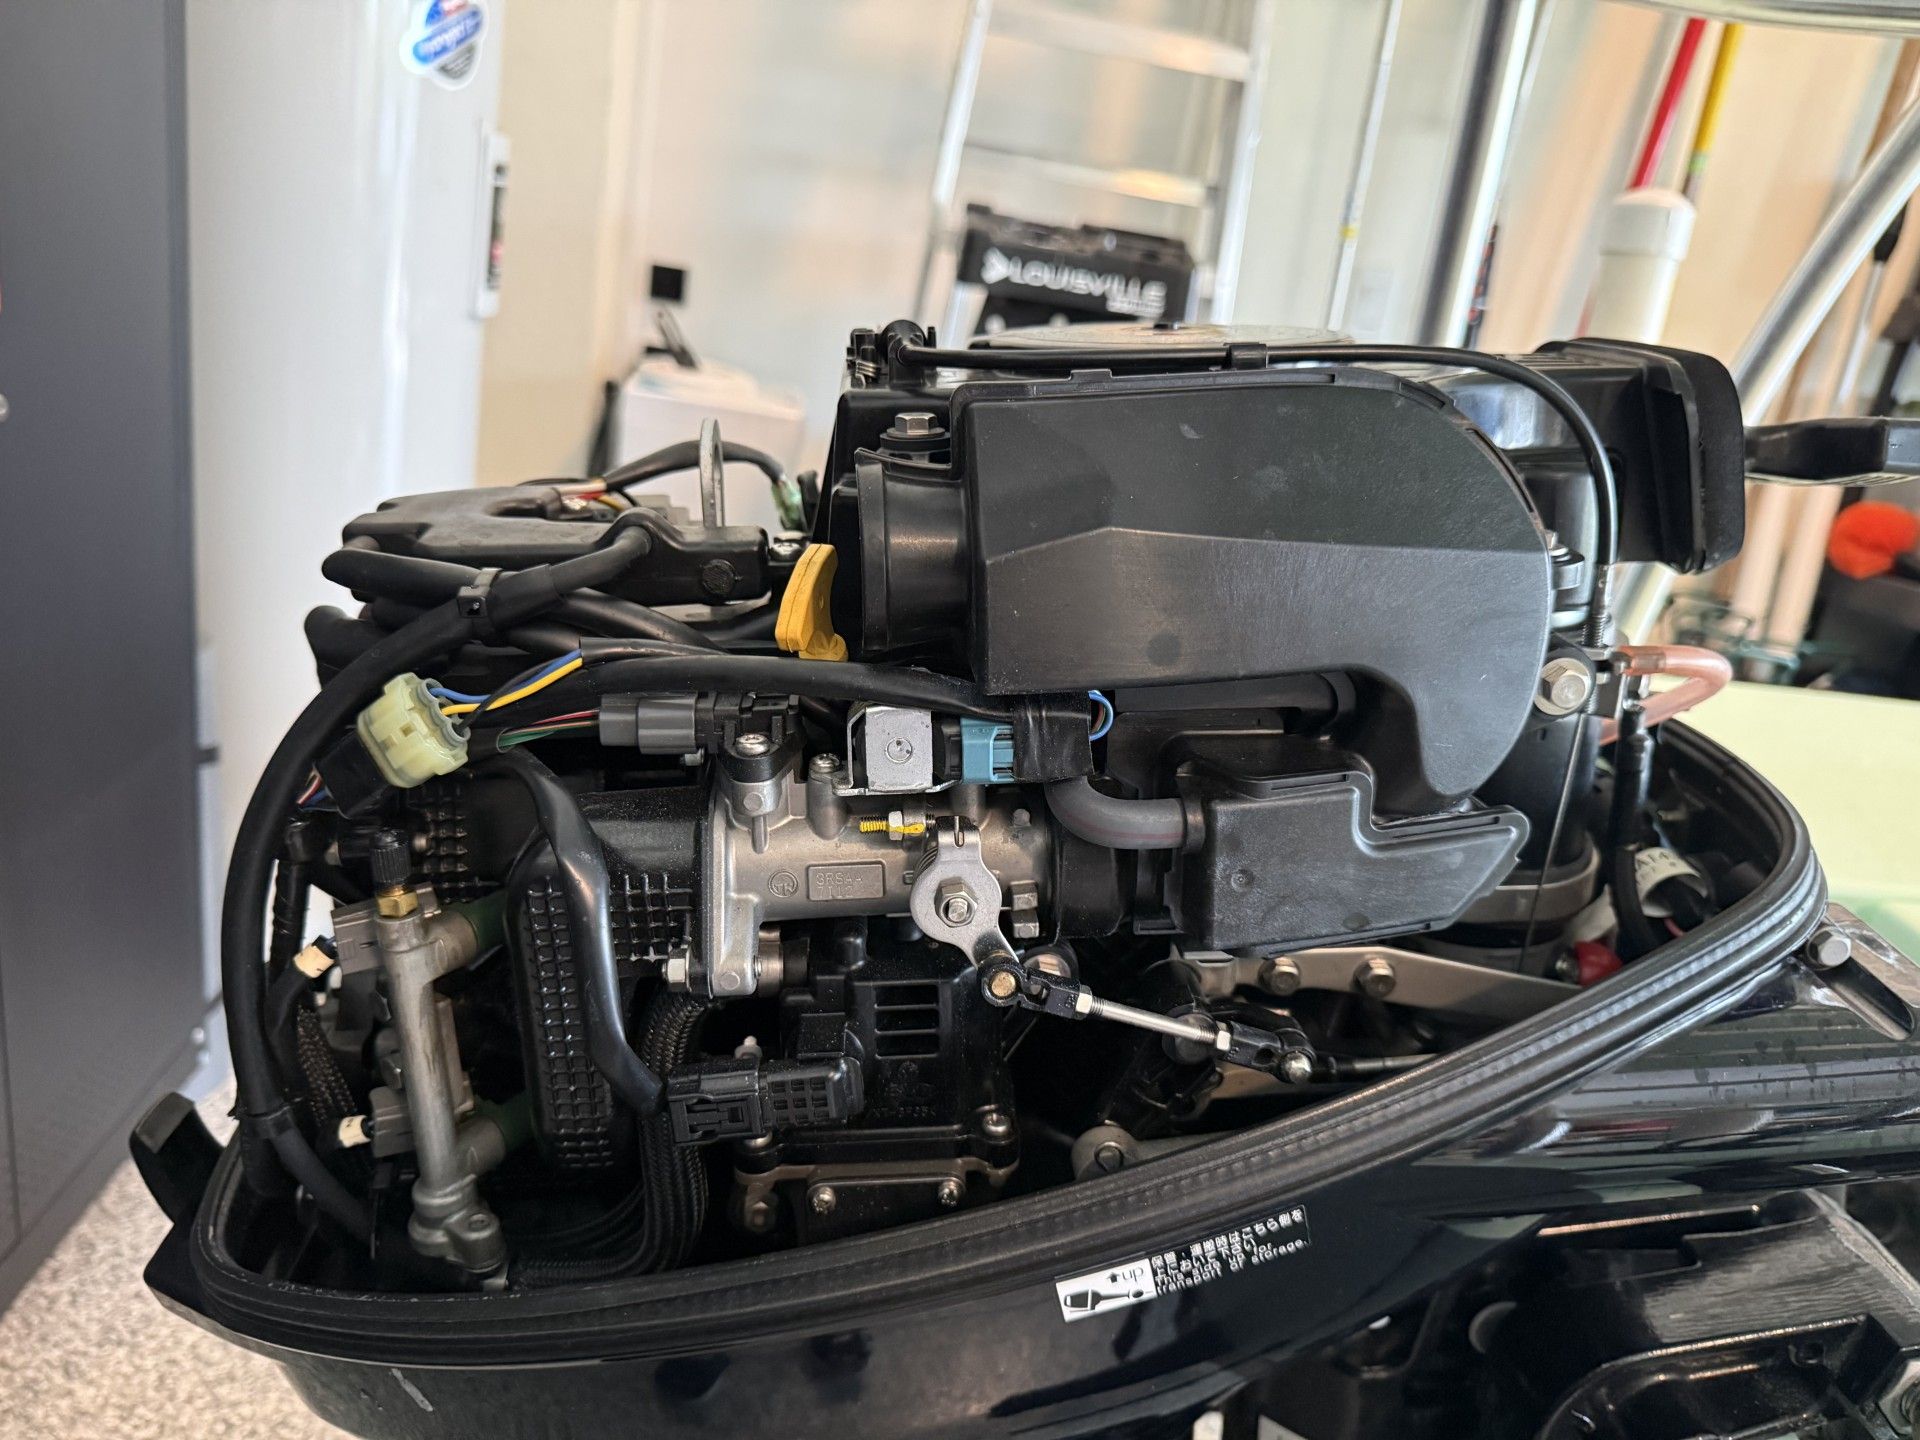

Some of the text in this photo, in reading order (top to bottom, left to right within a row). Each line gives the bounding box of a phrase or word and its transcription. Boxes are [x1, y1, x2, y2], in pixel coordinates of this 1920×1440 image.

[1008, 256, 1168, 304] LOUISVILLE
[1122, 1266, 1144, 1283] up
[1155, 1242, 1273, 1286] This side up for
[1156, 1266, 1224, 1296] transport
[1230, 1260, 1245, 1273] or
